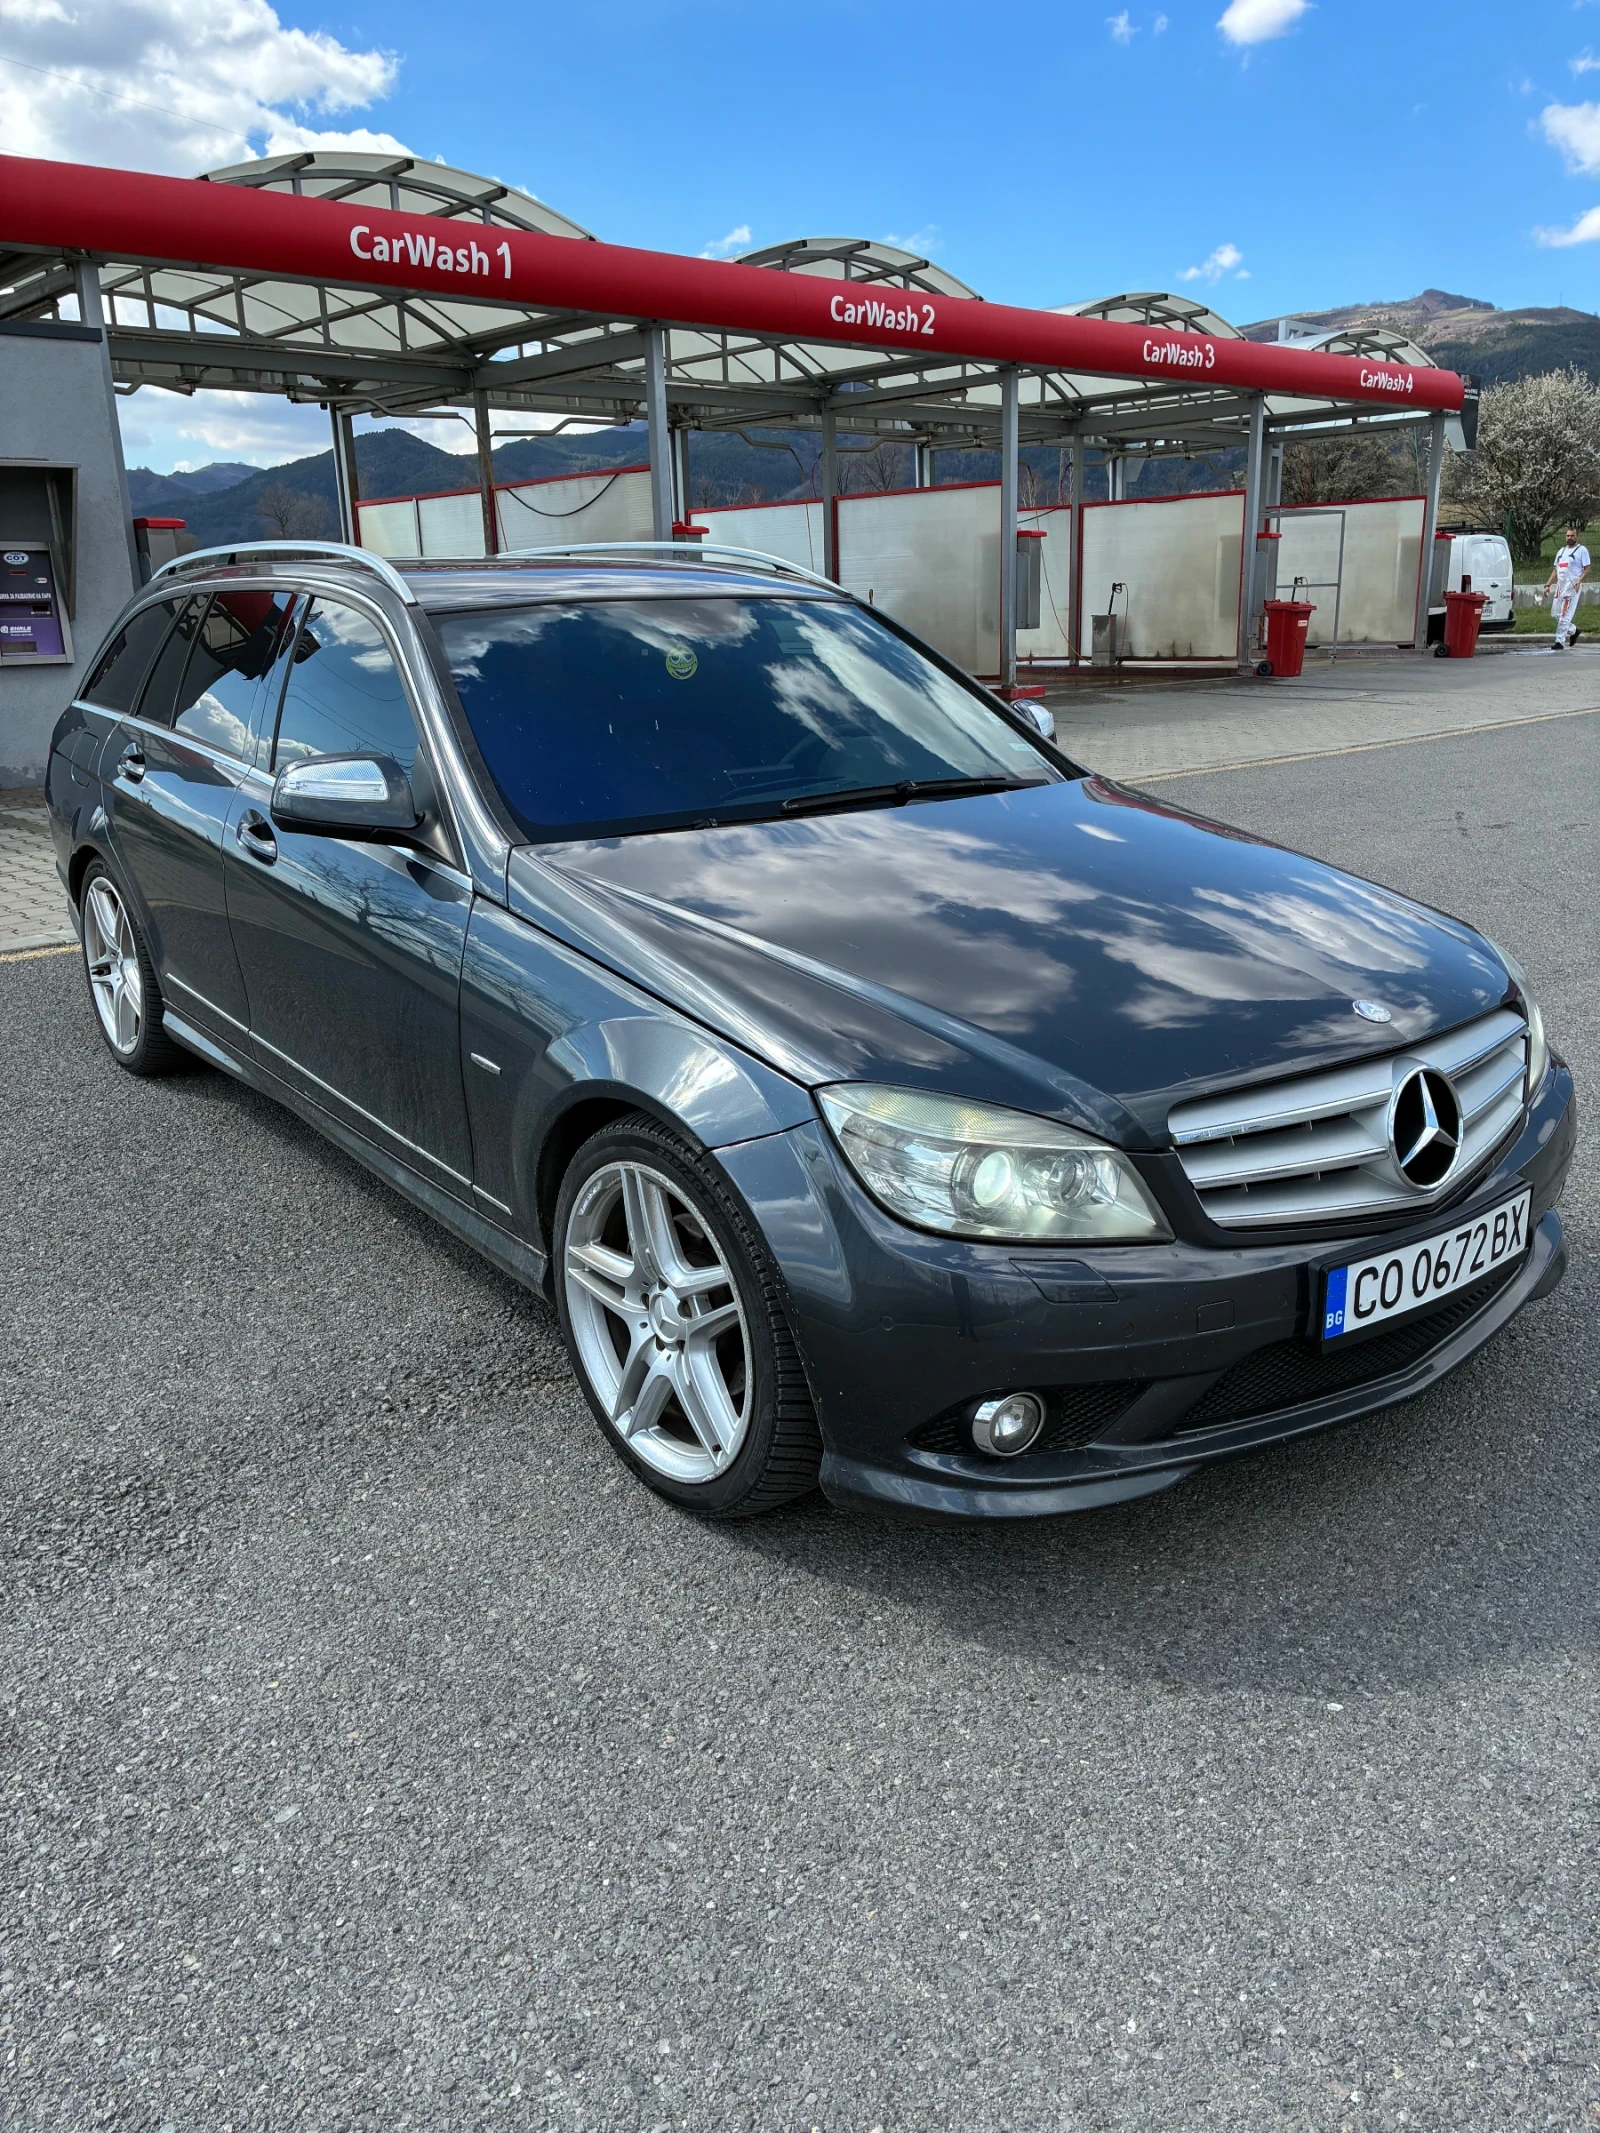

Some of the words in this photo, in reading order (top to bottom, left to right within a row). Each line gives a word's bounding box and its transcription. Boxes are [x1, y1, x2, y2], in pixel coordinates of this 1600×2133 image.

[350, 225, 489, 276] CarWash
[496, 241, 512, 279] 1
[830, 295, 918, 332] CarWash
[921, 304, 935, 335] 2
[1143, 340, 1202, 367] CarWash
[1205, 343, 1215, 368] 3
[1360, 369, 1405, 391] CarWash
[1405, 373, 1413, 393] 4
[1353, 1258, 1403, 1319] CO
[1412, 1222, 1488, 1298] 0672
[1491, 1199, 1526, 1262] BX
[1326, 1310, 1343, 1329] BG
